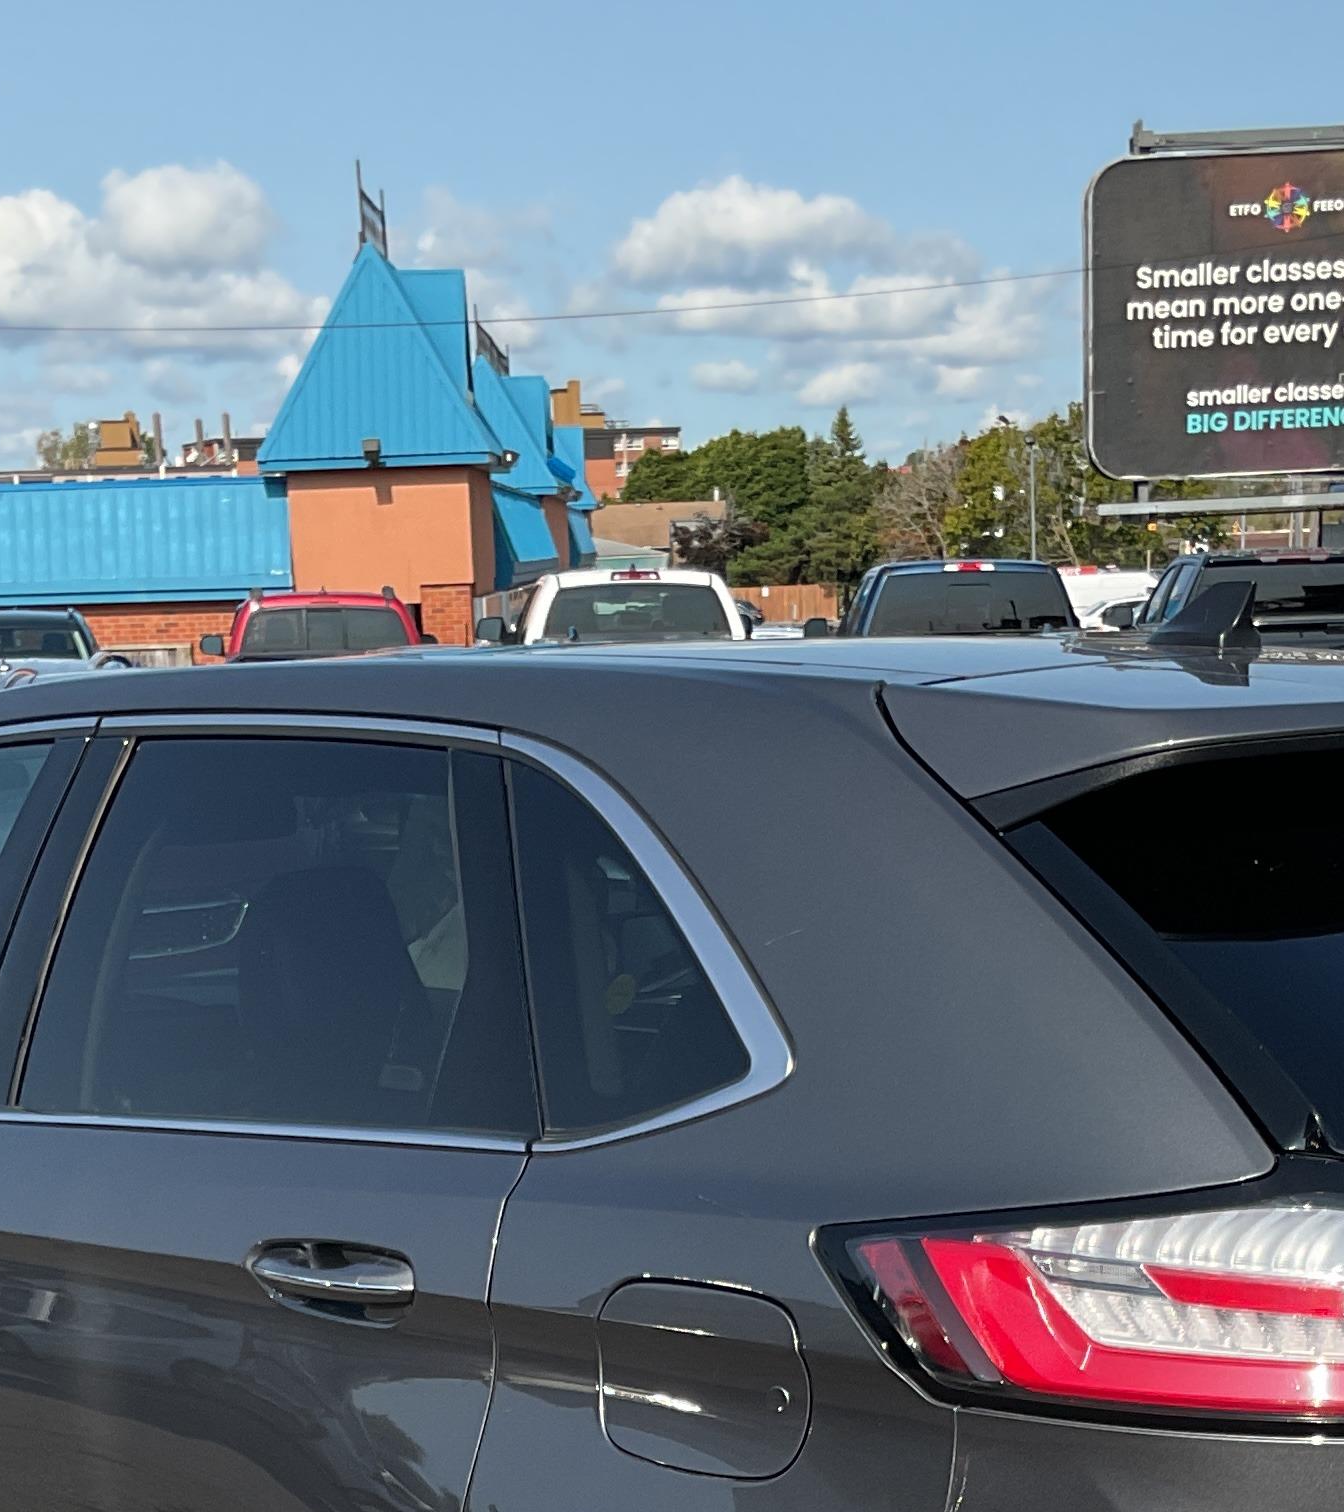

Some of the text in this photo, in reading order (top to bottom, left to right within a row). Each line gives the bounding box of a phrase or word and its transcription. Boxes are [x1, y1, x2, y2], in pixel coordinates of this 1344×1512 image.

[1229, 203, 1262, 217] ETFO
[1313, 199, 1344, 212] FEEO
[1136, 261, 1241, 290] Smaller
[1126, 298, 1206, 321] mean
[1212, 294, 1285, 317] more
[1152, 324, 1215, 350] time
[1220, 320, 1258, 346] for
[1263, 320, 1339, 349] every
[1186, 383, 1272, 408] smaller
[1185, 411, 1229, 434] BIG
